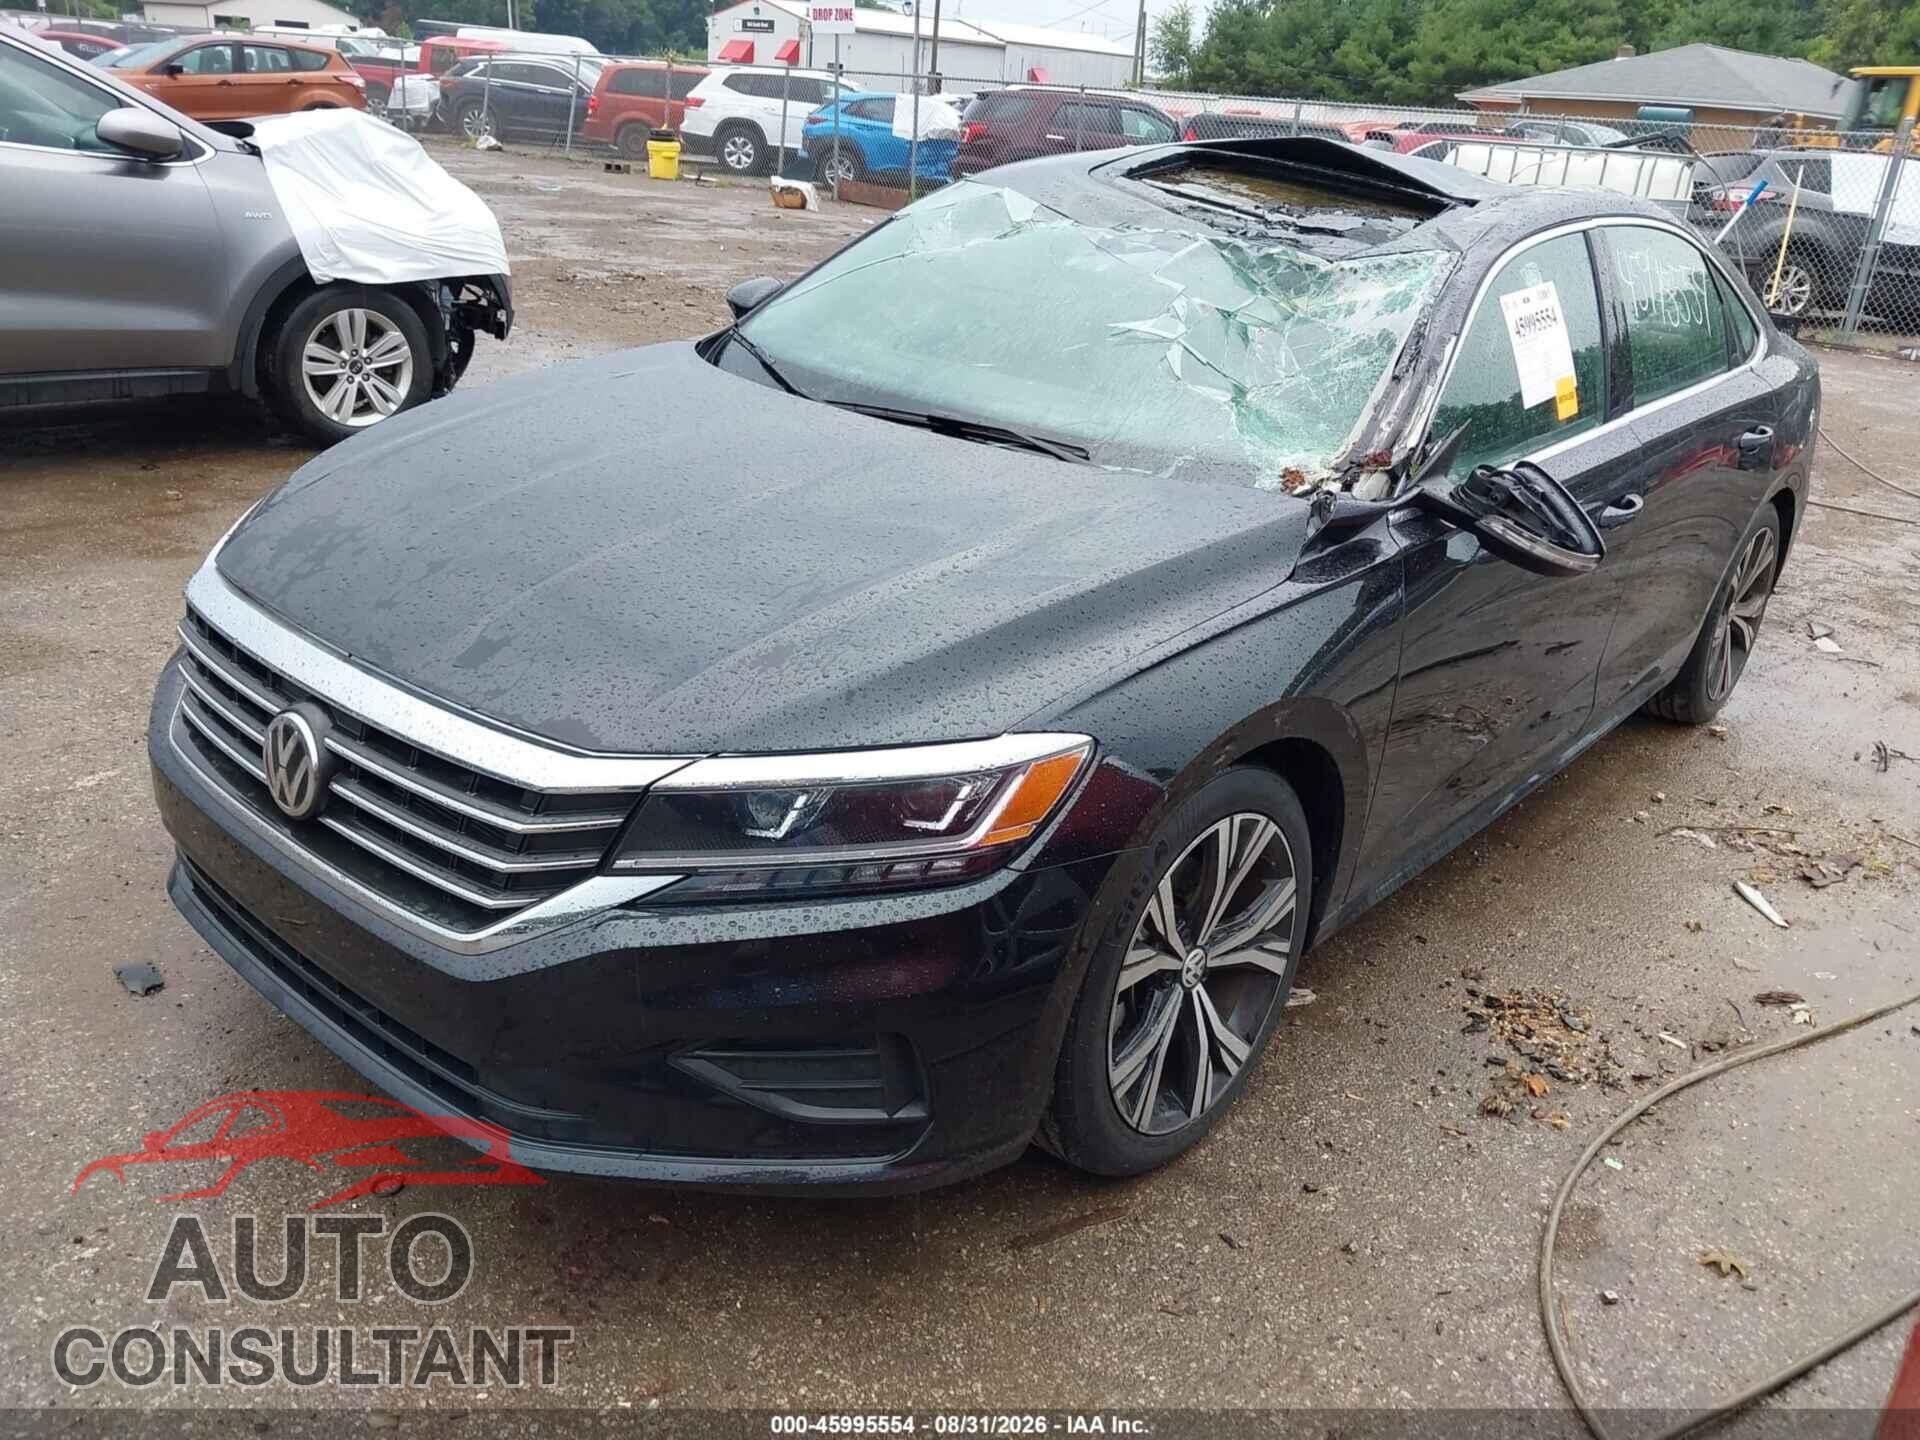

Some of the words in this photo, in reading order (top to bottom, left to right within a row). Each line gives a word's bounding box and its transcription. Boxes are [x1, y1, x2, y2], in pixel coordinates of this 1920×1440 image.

[812, 7, 833, 21] DROP
[835, 7, 854, 21] ZONE
[1514, 304, 1558, 338] 45995554
